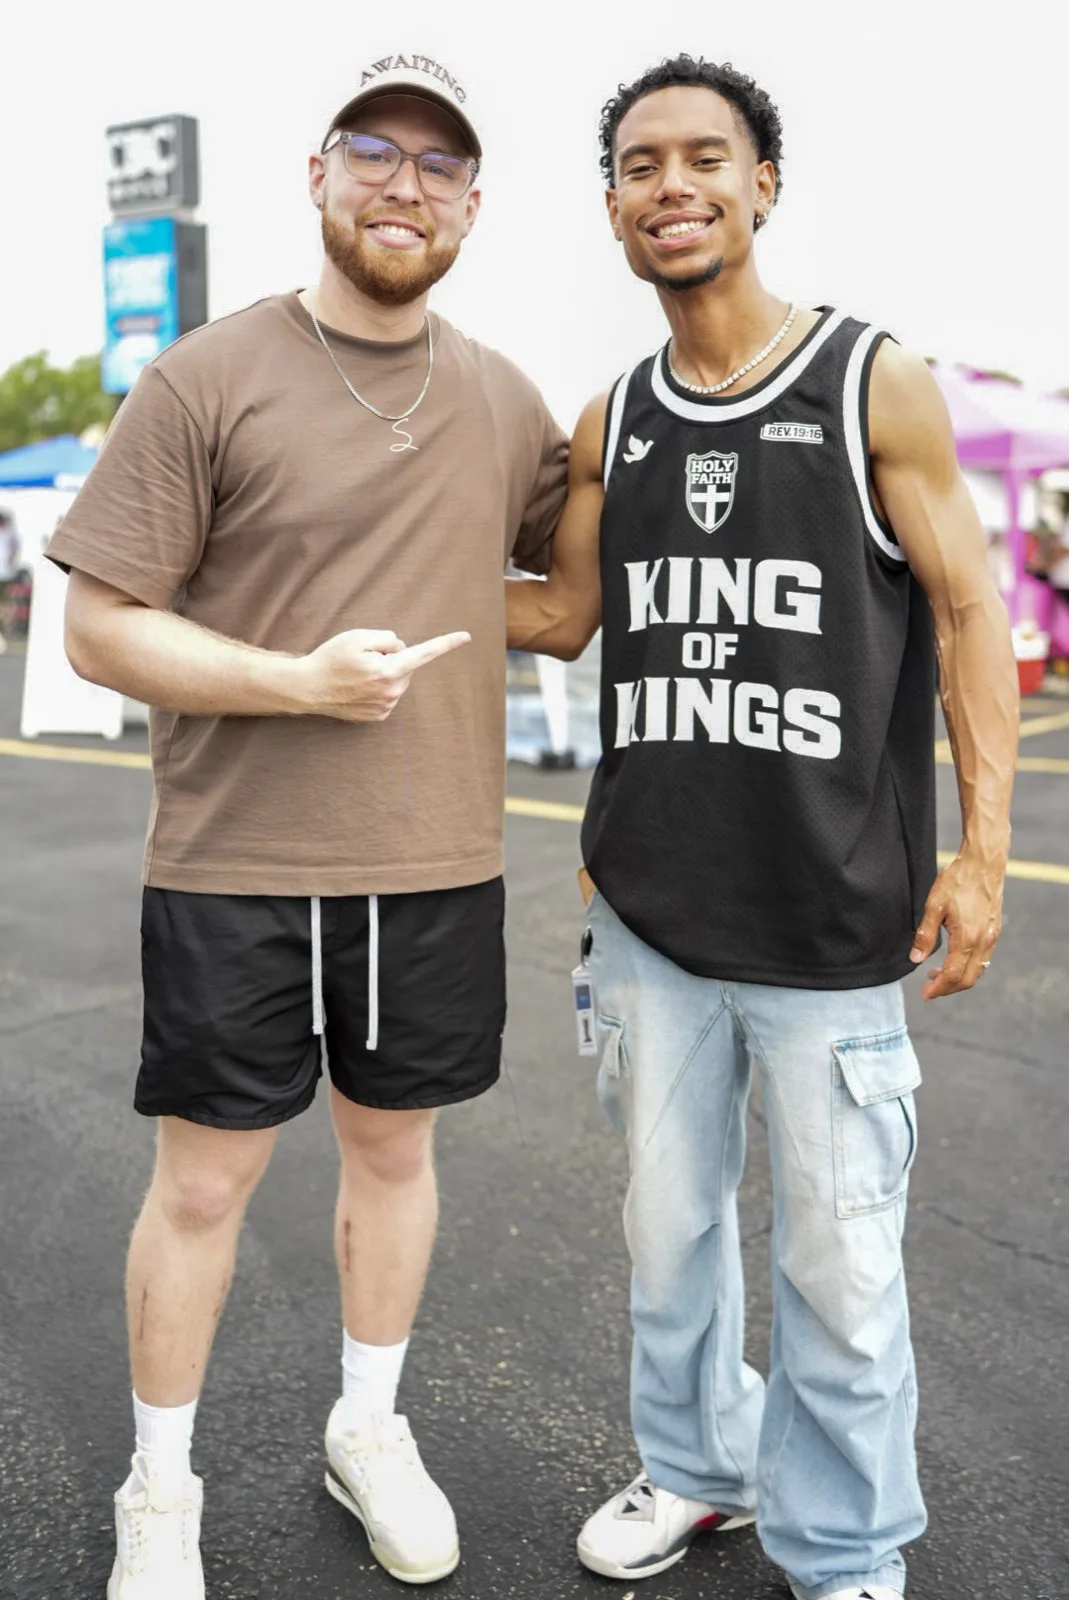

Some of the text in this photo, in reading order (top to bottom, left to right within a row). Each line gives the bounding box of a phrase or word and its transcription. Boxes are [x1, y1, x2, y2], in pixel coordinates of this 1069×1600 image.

[359, 54, 467, 104] AWAITING
[690, 472, 732, 484] FAITH
[691, 459, 734, 473] HOLY
[623, 556, 823, 635] KING
[682, 631, 739, 670] OF
[613, 676, 842, 760] KINGS
